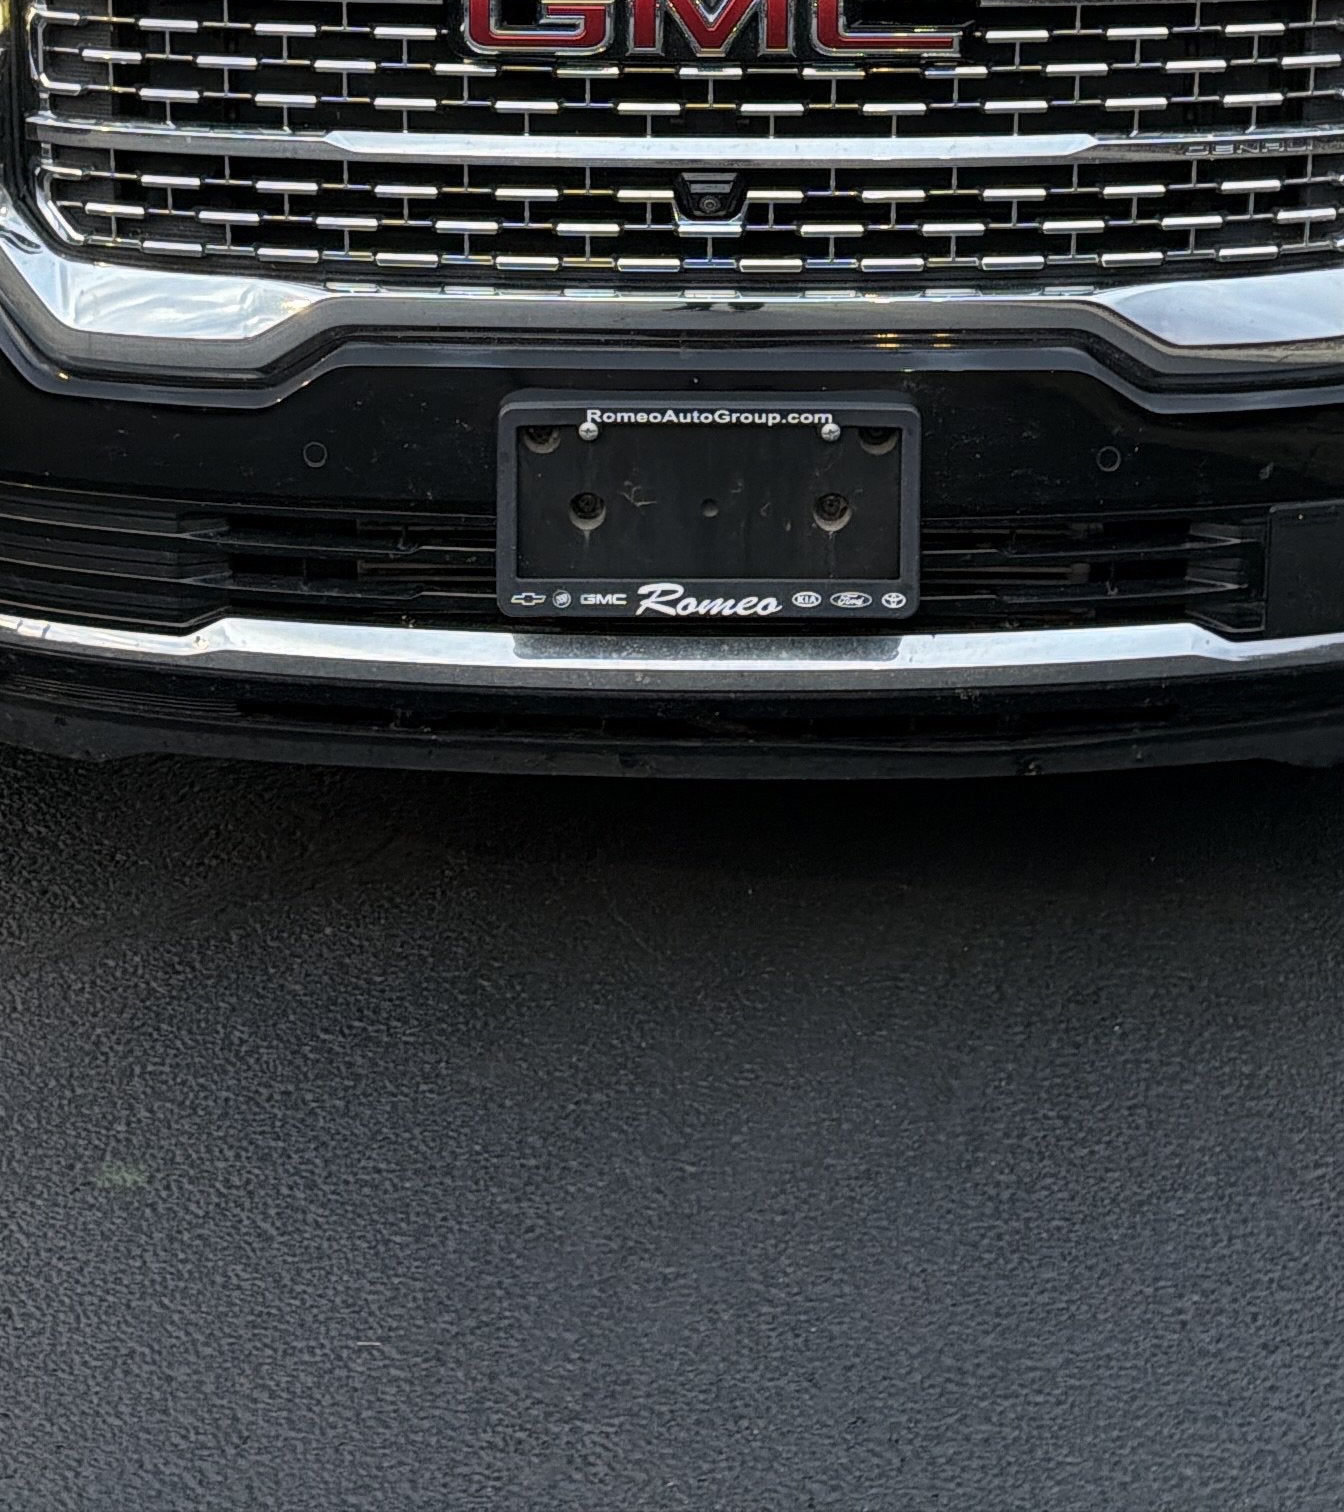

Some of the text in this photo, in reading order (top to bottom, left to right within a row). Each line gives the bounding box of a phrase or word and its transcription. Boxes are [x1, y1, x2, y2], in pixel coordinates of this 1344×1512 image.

[1185, 142, 1313, 156] DENALI
[586, 409, 833, 426] RomeoAutoGroup.com
[580, 583, 865, 616] GMC Romeo KIA Ford
